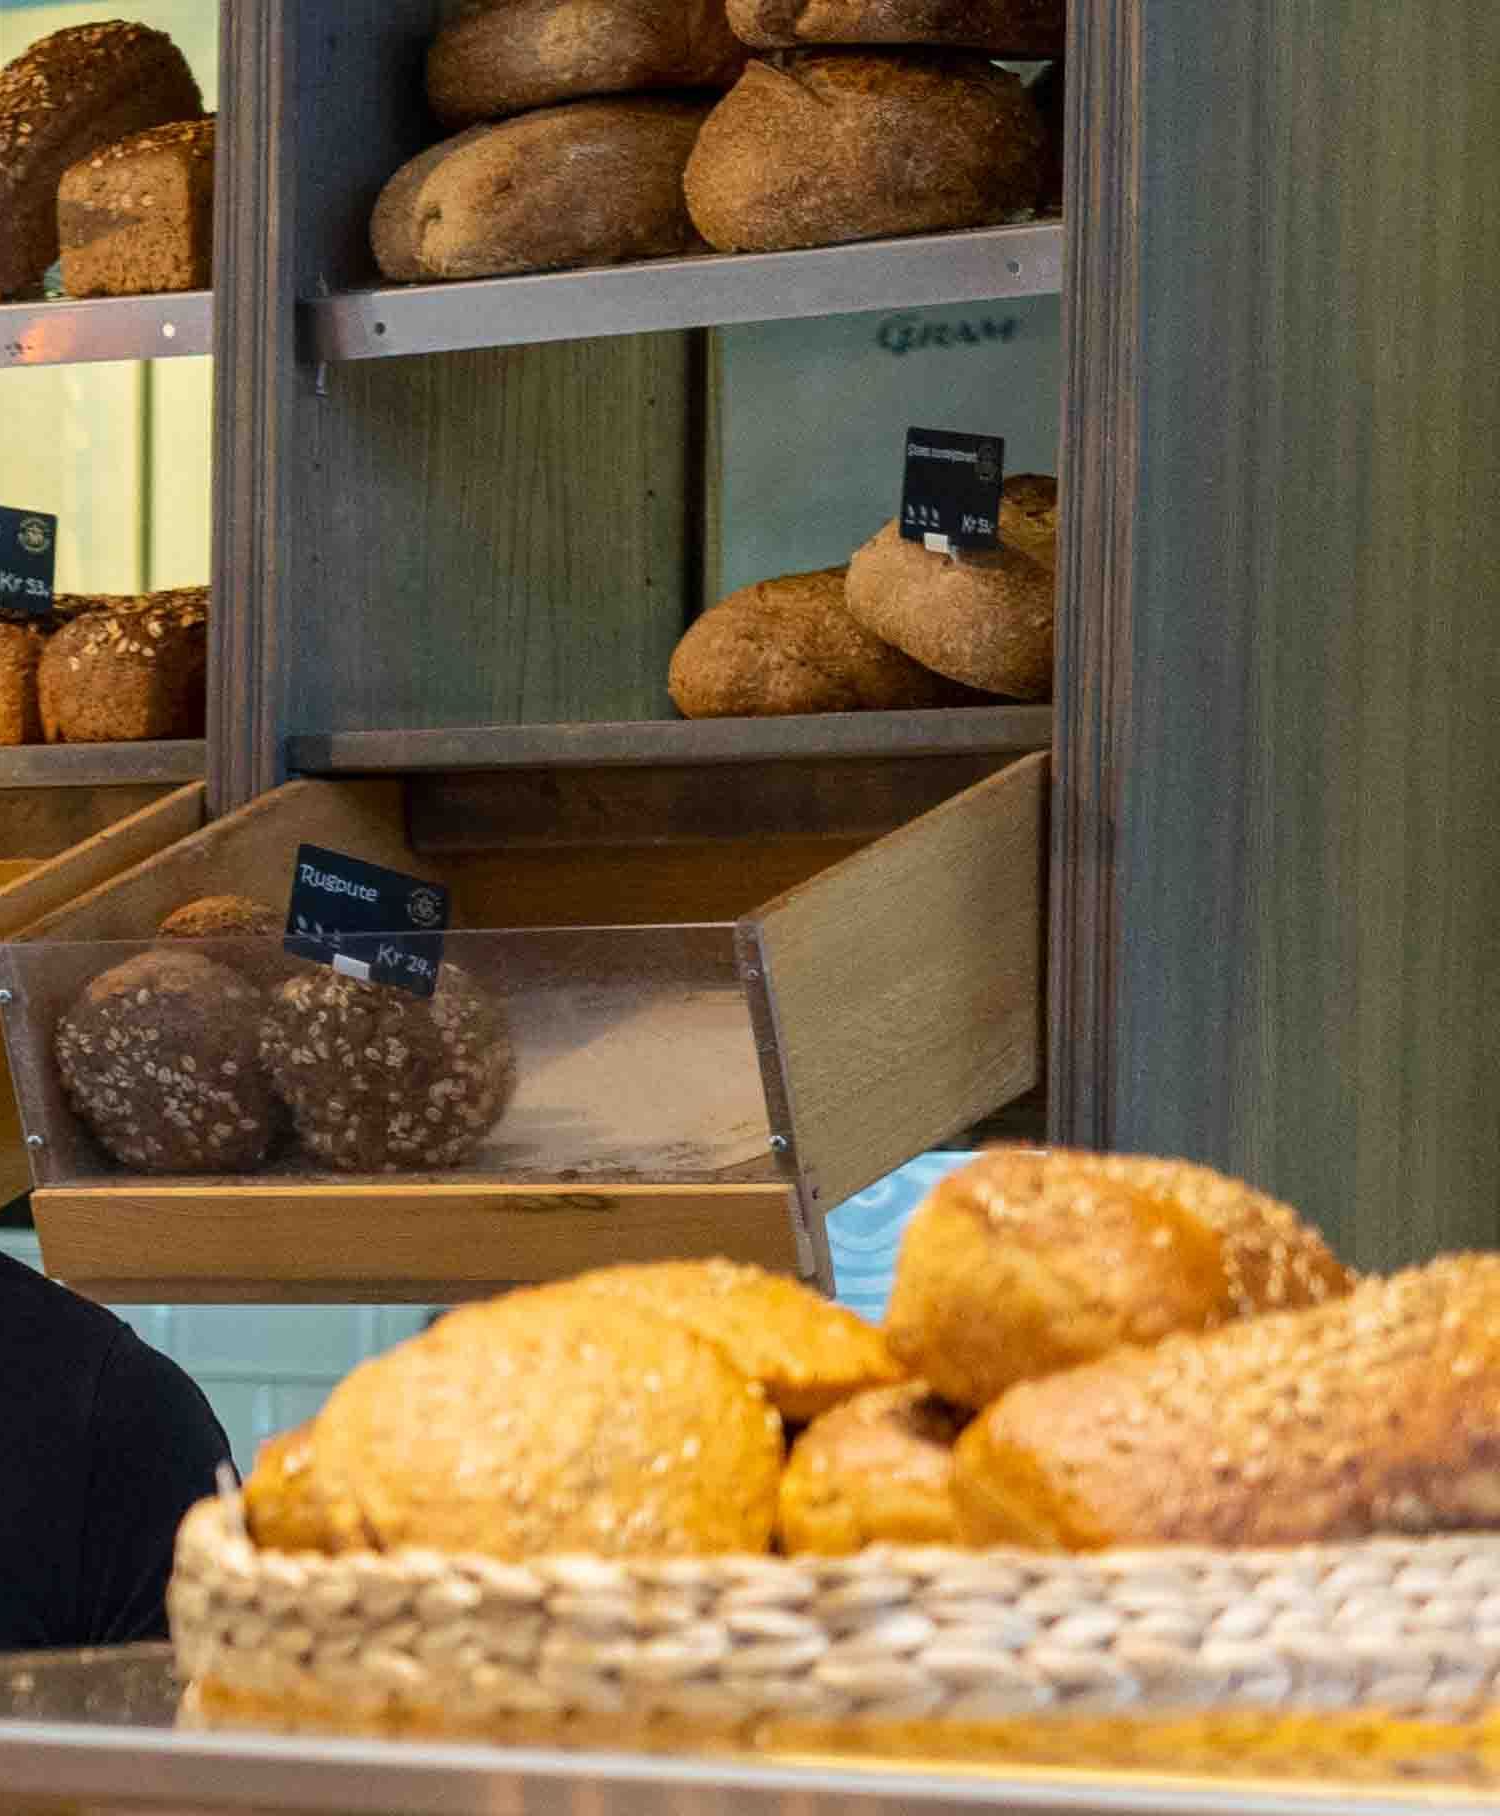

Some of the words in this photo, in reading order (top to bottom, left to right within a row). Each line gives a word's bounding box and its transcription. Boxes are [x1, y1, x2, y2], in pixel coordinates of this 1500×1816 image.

[0, 571, 23, 592] Kr
[300, 863, 379, 902] Rugpute
[377, 943, 403, 967] Kr
